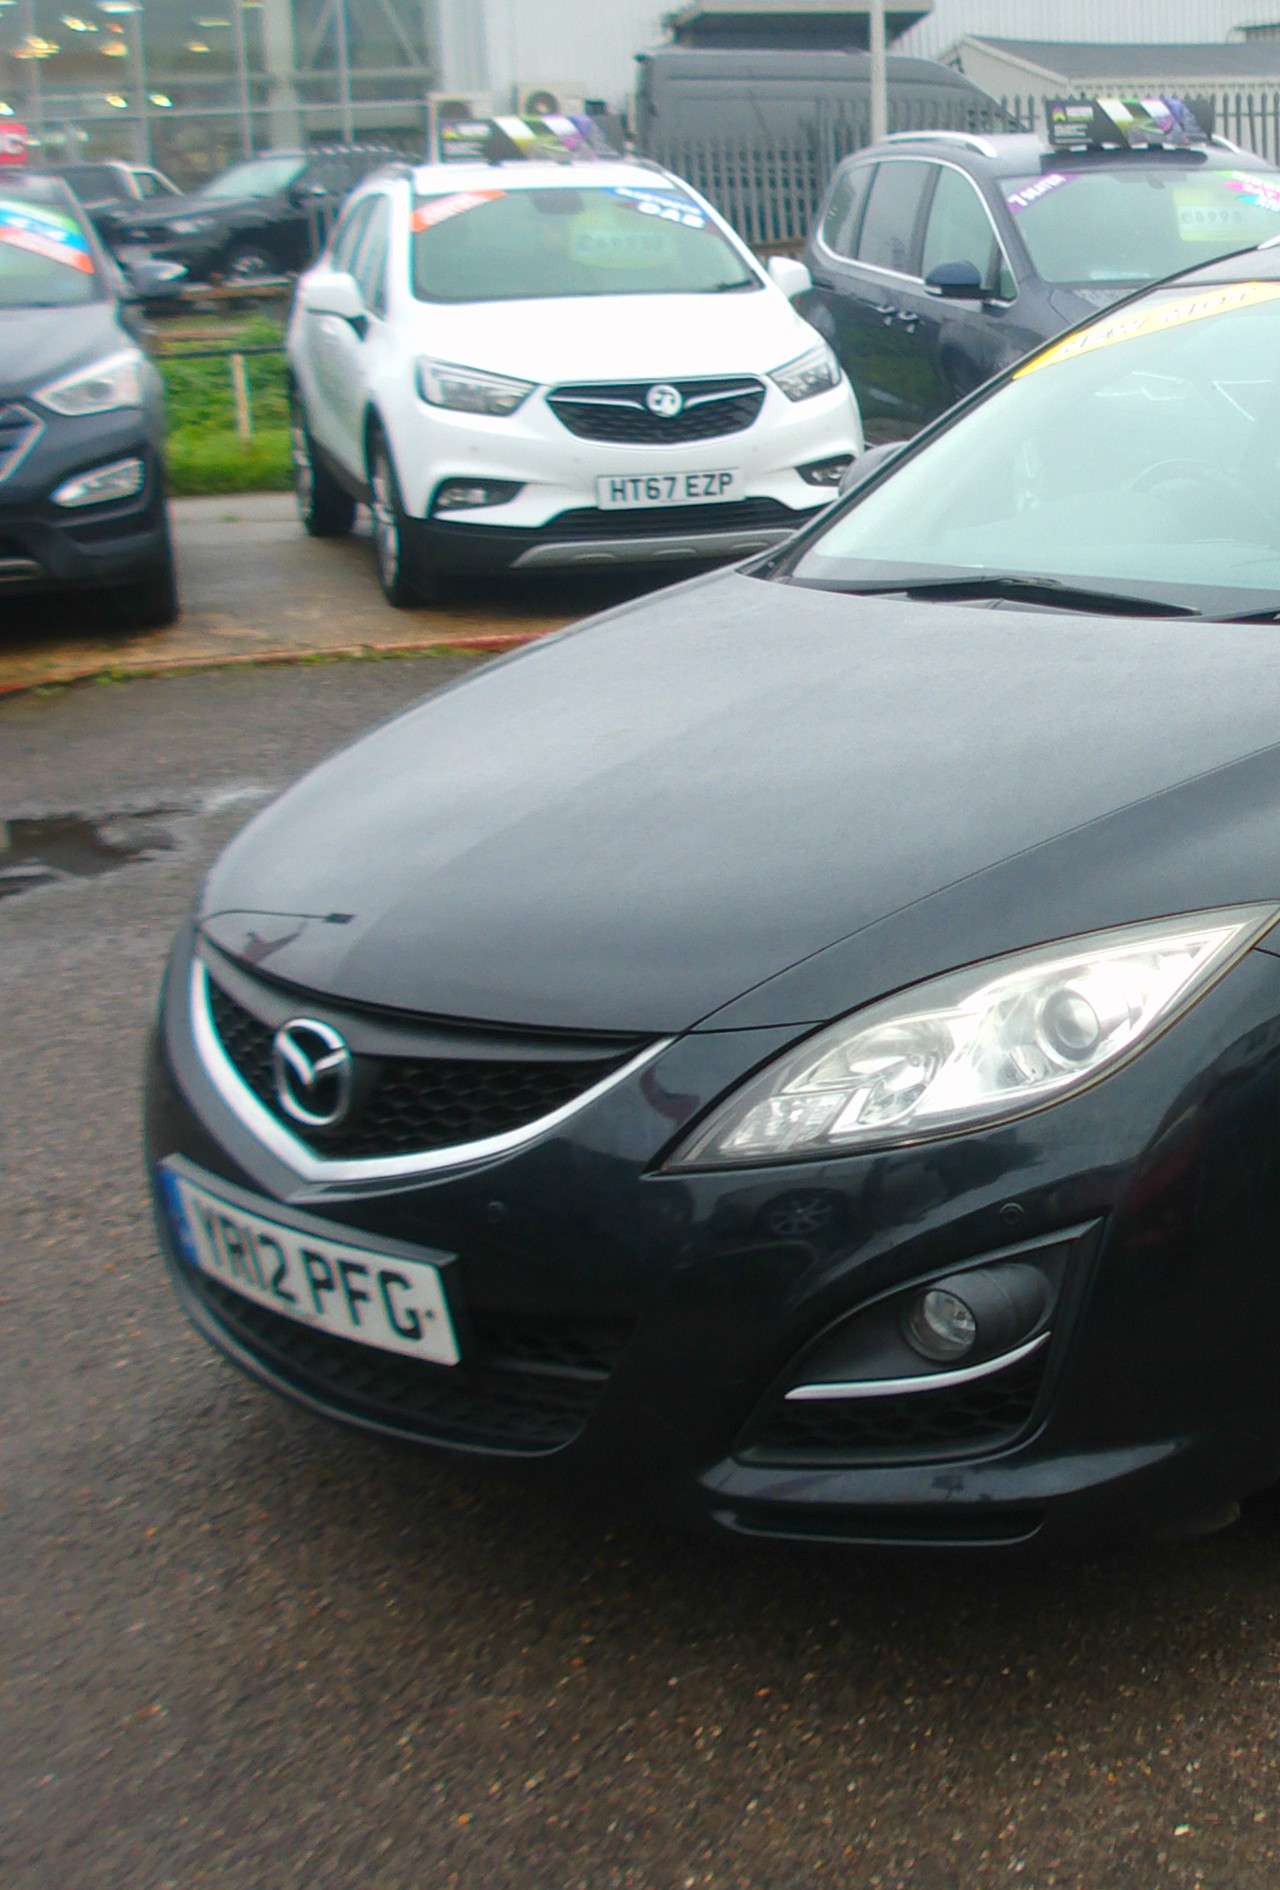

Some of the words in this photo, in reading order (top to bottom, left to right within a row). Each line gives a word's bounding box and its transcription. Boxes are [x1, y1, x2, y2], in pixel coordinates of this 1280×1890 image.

[611, 476, 677, 502] HT67
[685, 472, 733, 498] EZP
[300, 1248, 424, 1342] PFG
